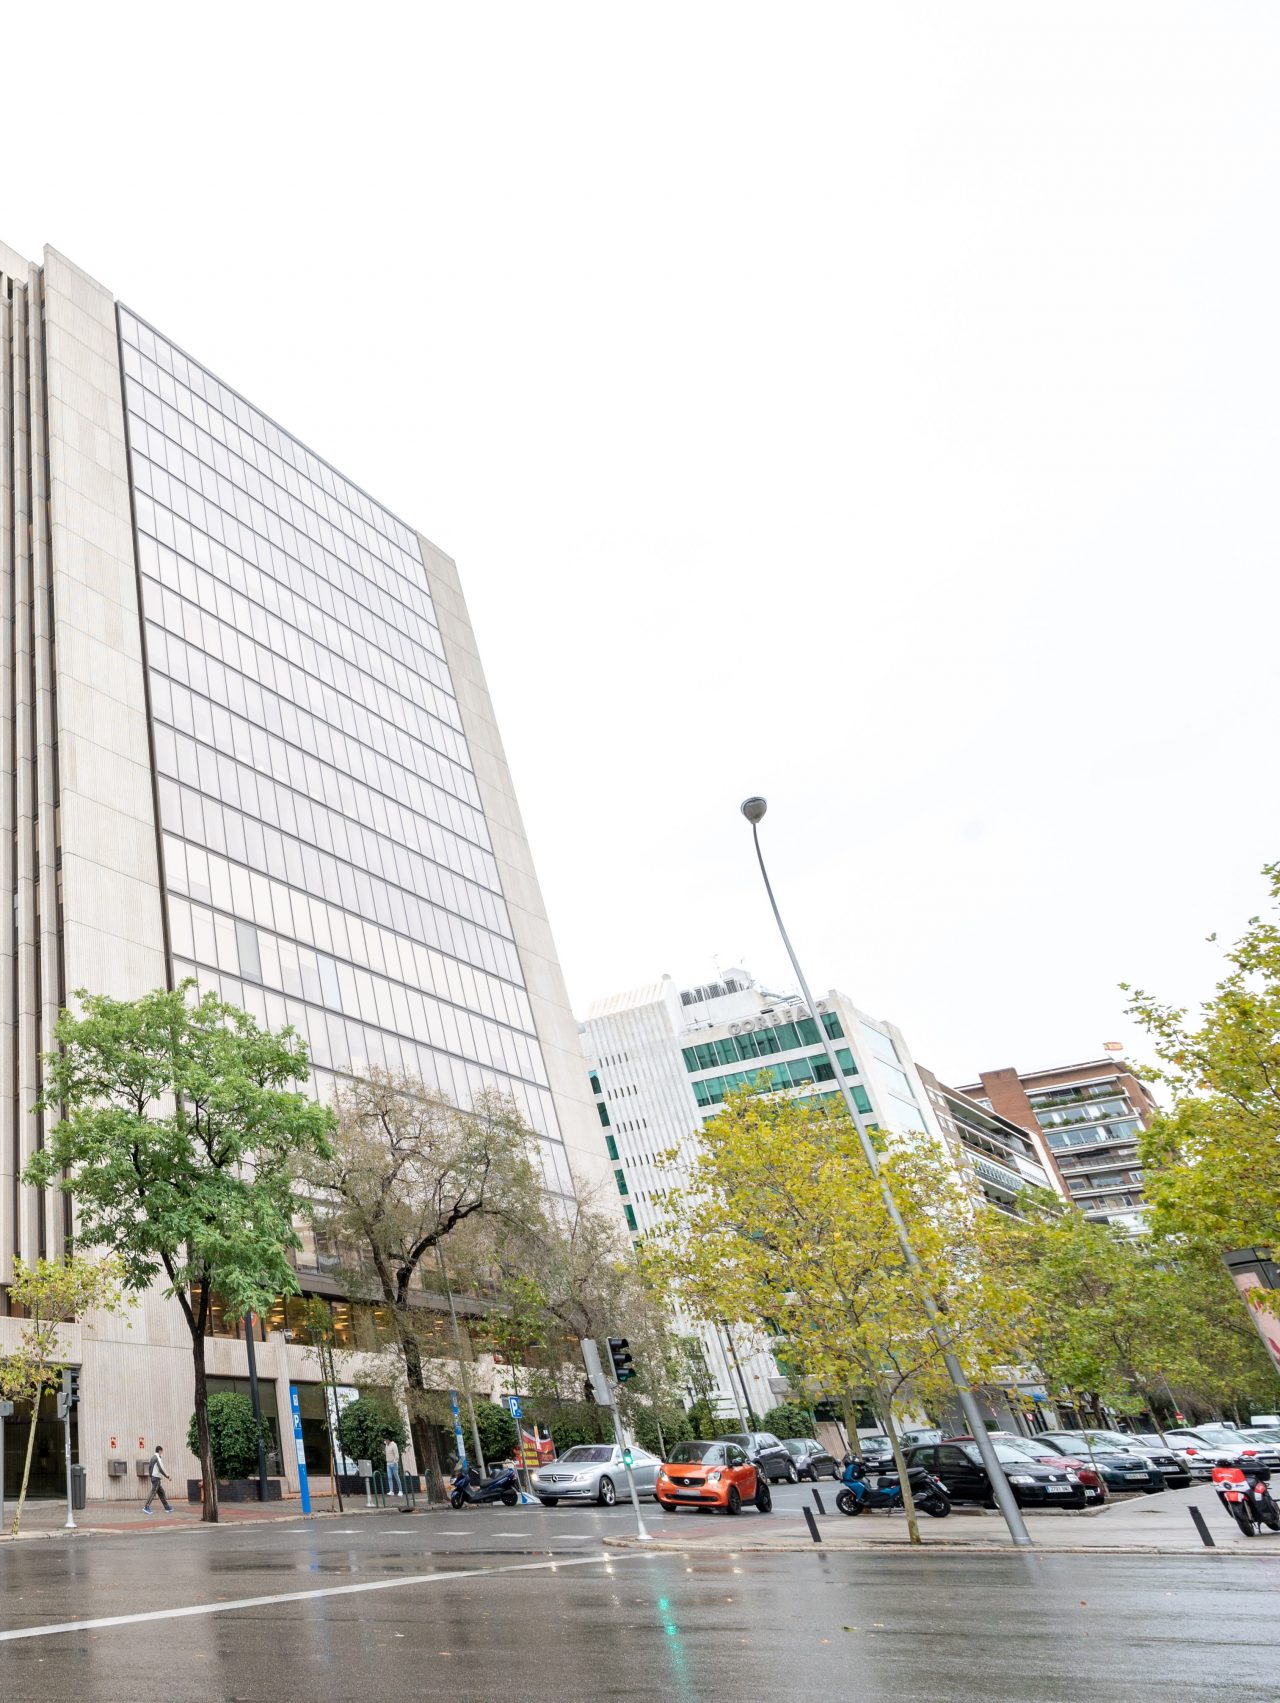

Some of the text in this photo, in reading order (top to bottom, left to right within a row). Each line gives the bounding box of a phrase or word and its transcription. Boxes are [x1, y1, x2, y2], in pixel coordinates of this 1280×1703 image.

[728, 1001, 831, 1036] GORBEA 2
[511, 1399, 518, 1415] P
[294, 1414, 300, 1428] P
